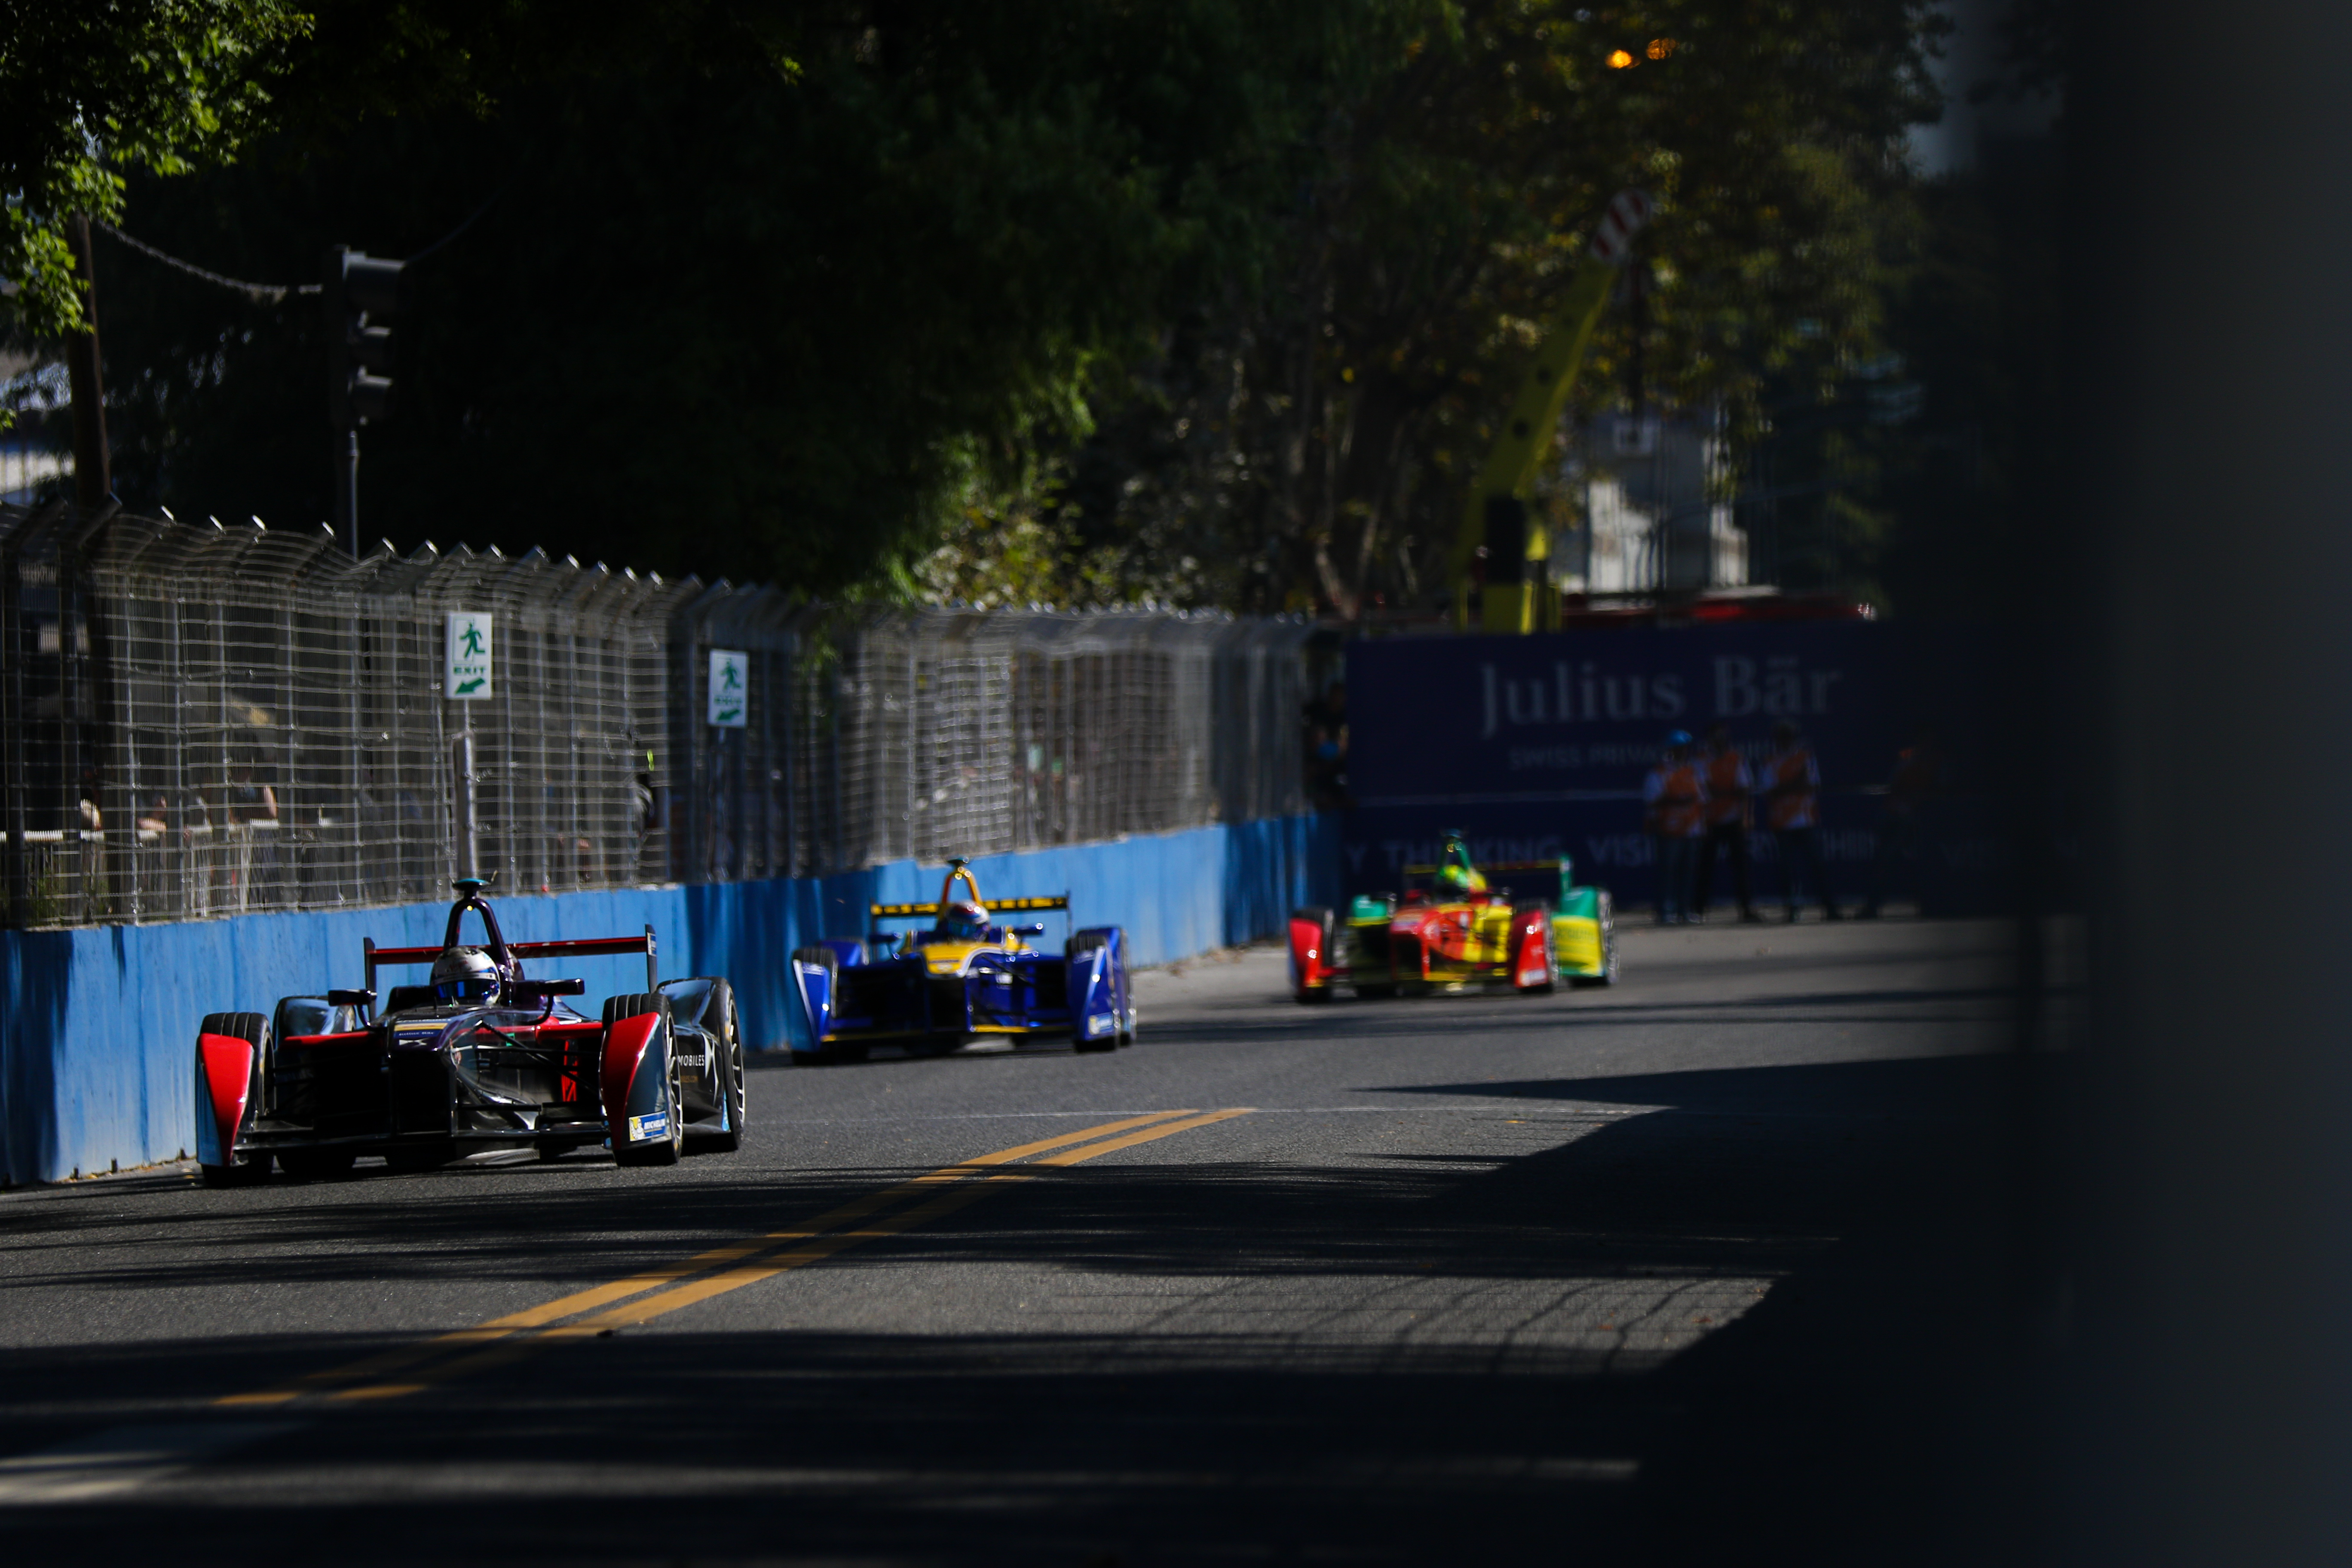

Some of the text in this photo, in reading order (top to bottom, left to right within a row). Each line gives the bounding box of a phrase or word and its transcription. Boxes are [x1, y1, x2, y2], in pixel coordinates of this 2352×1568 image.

[1480, 654, 1844, 740] Julius Bär
[1509, 741, 1660, 770] SWISS PRIVA
